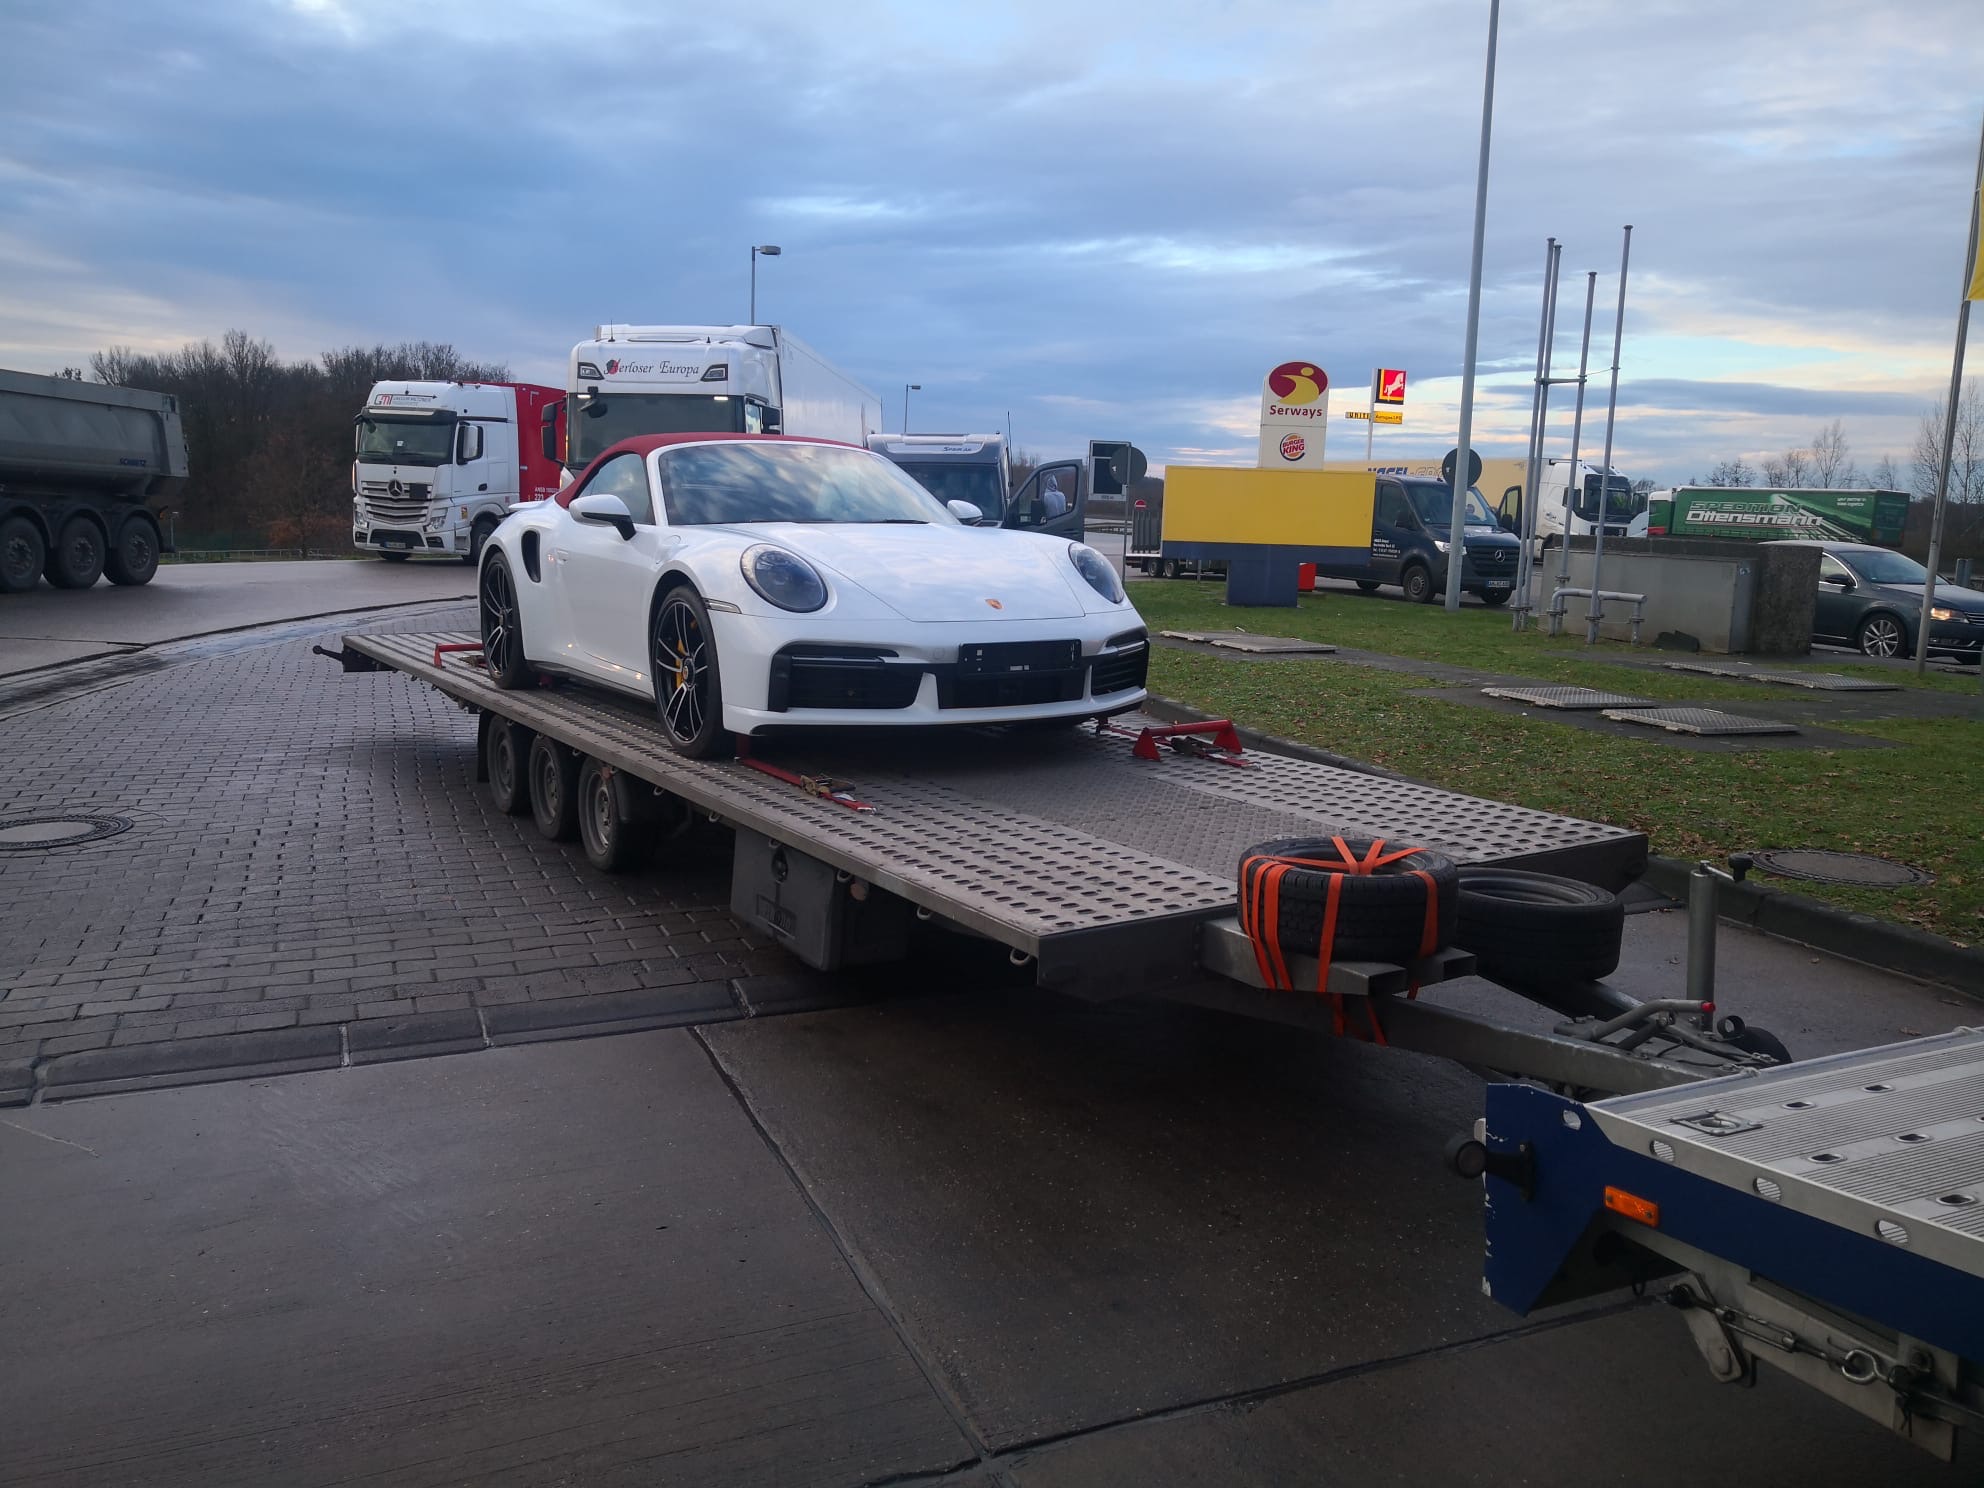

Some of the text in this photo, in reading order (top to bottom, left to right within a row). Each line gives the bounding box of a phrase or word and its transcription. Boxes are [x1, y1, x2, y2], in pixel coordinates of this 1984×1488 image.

[660, 360, 700, 377] Europa
[1269, 404, 1323, 419] Serways
[1282, 438, 1304, 448] BURGER
[1283, 443, 1304, 455] KING
[1686, 510, 1824, 526] Ottensmann
